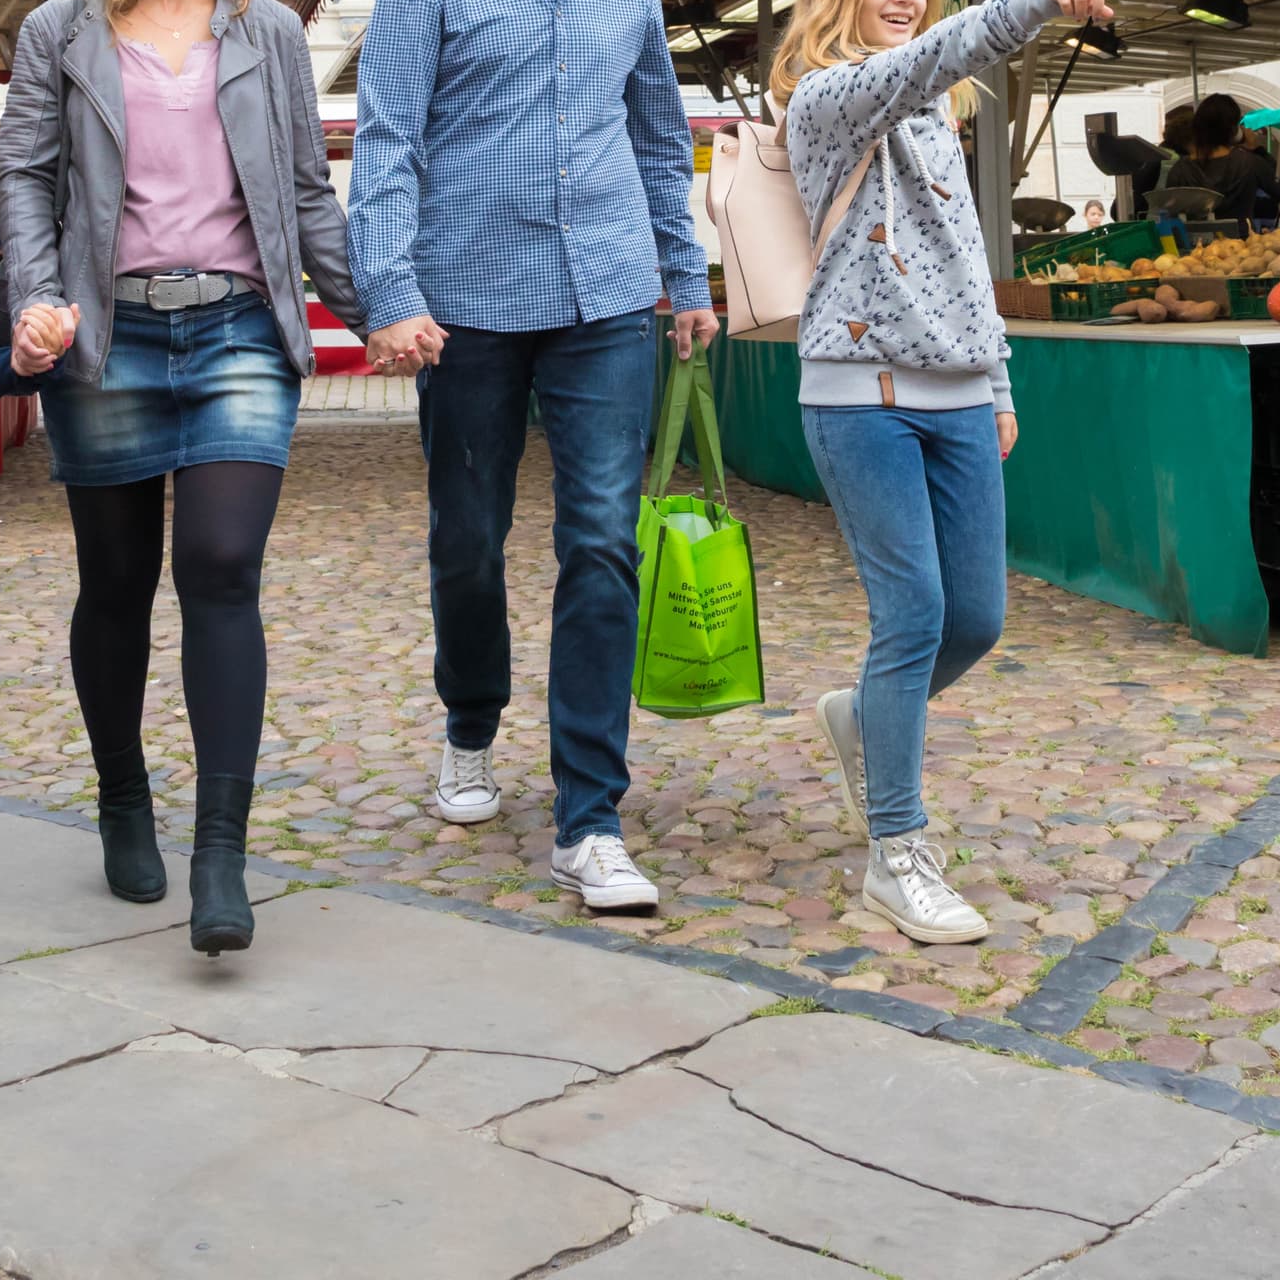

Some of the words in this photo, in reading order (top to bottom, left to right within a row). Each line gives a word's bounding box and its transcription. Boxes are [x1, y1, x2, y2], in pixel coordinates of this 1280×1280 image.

[704, 586, 715, 597] Sie
[717, 581, 733, 591] uns
[709, 590, 742, 606] Samstag
[672, 605, 686, 614] auf
